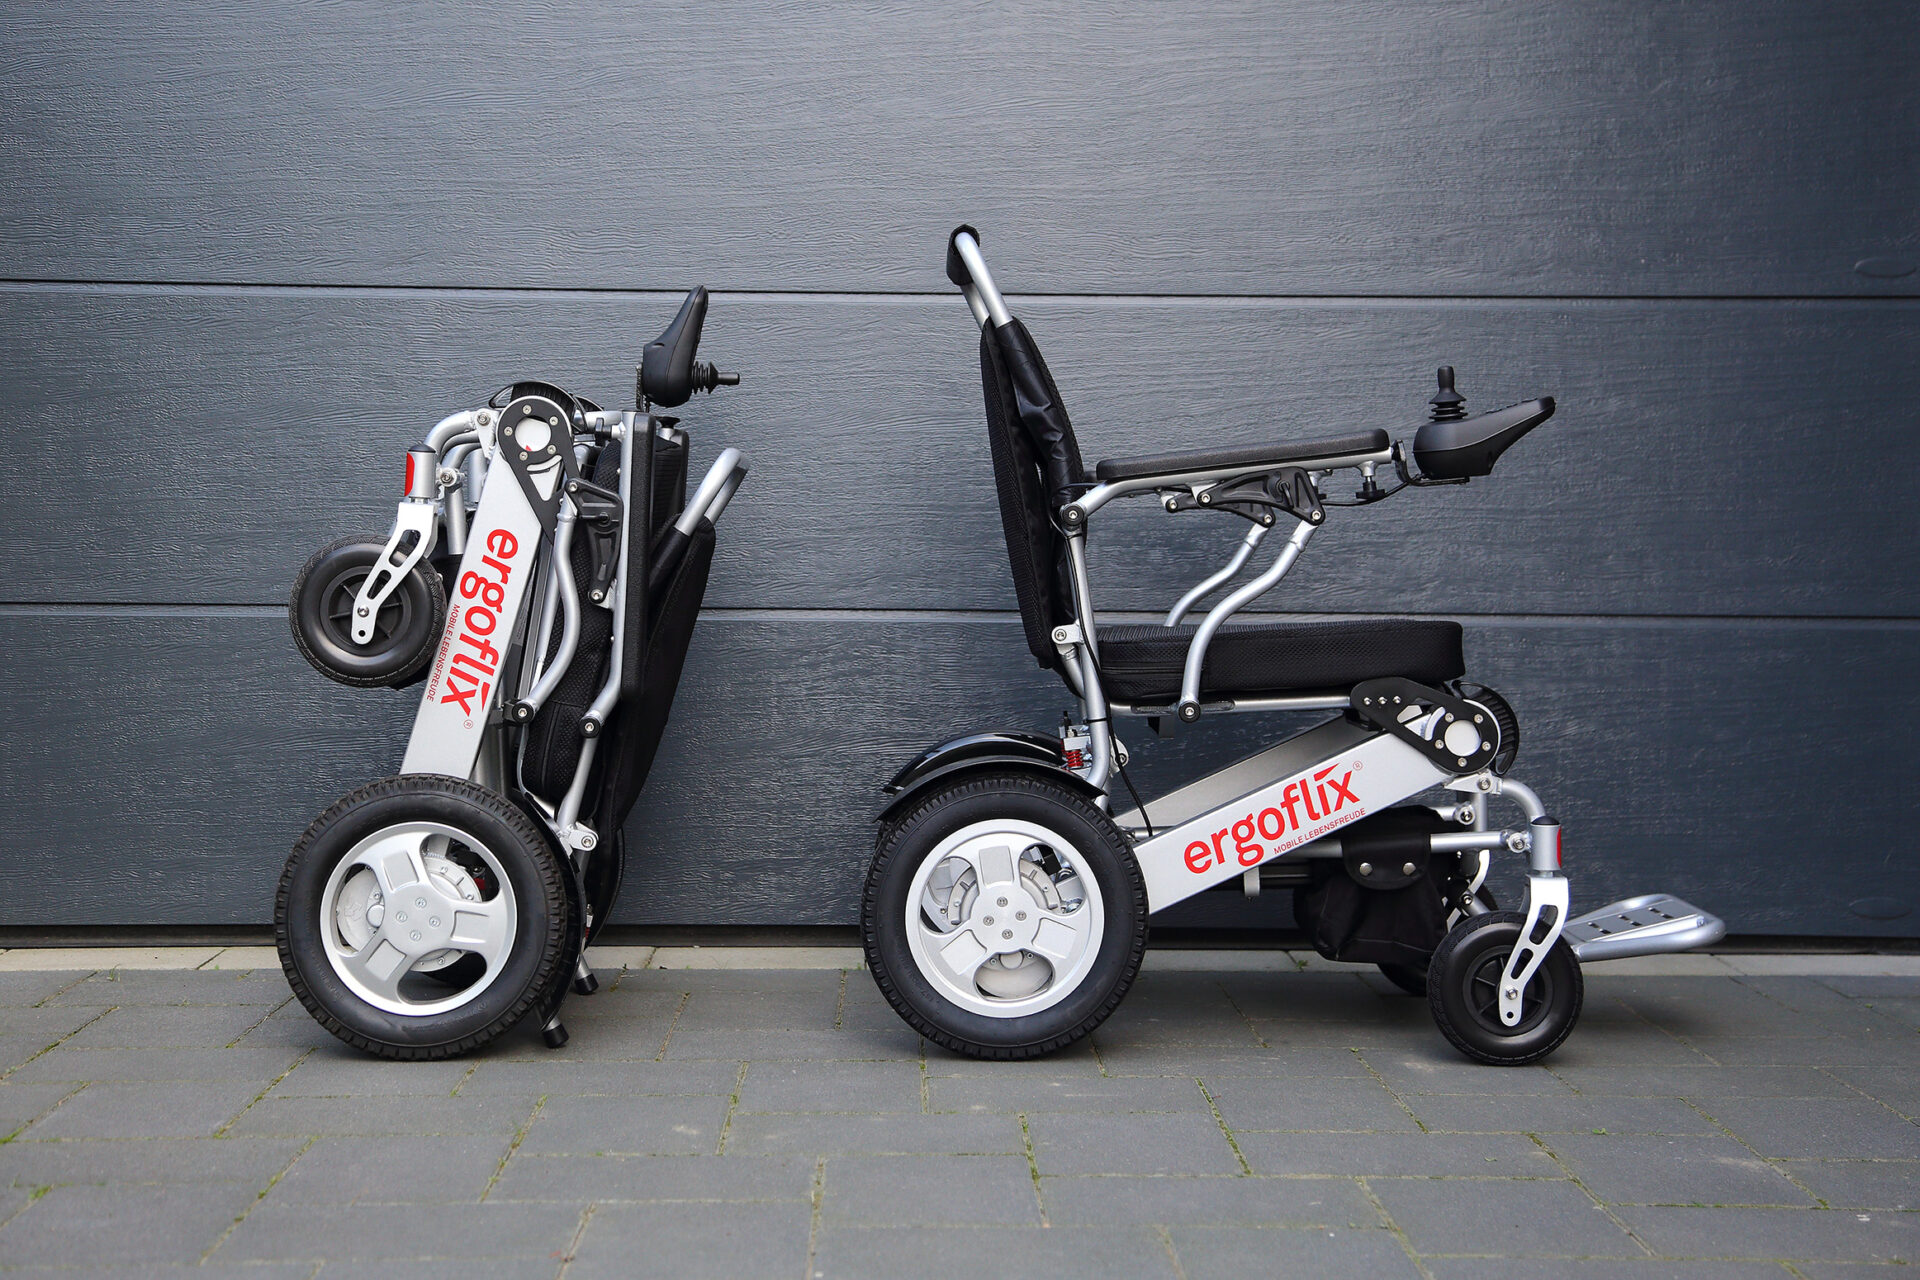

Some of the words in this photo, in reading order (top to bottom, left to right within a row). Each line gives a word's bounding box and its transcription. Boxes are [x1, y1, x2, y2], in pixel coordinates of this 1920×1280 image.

[446, 603, 461, 636] MOBILE
[426, 635, 450, 702] LEBENSFREUDE
[1273, 835, 1304, 855] MOBILE
[1304, 807, 1367, 841] LEBENSFREUDE
